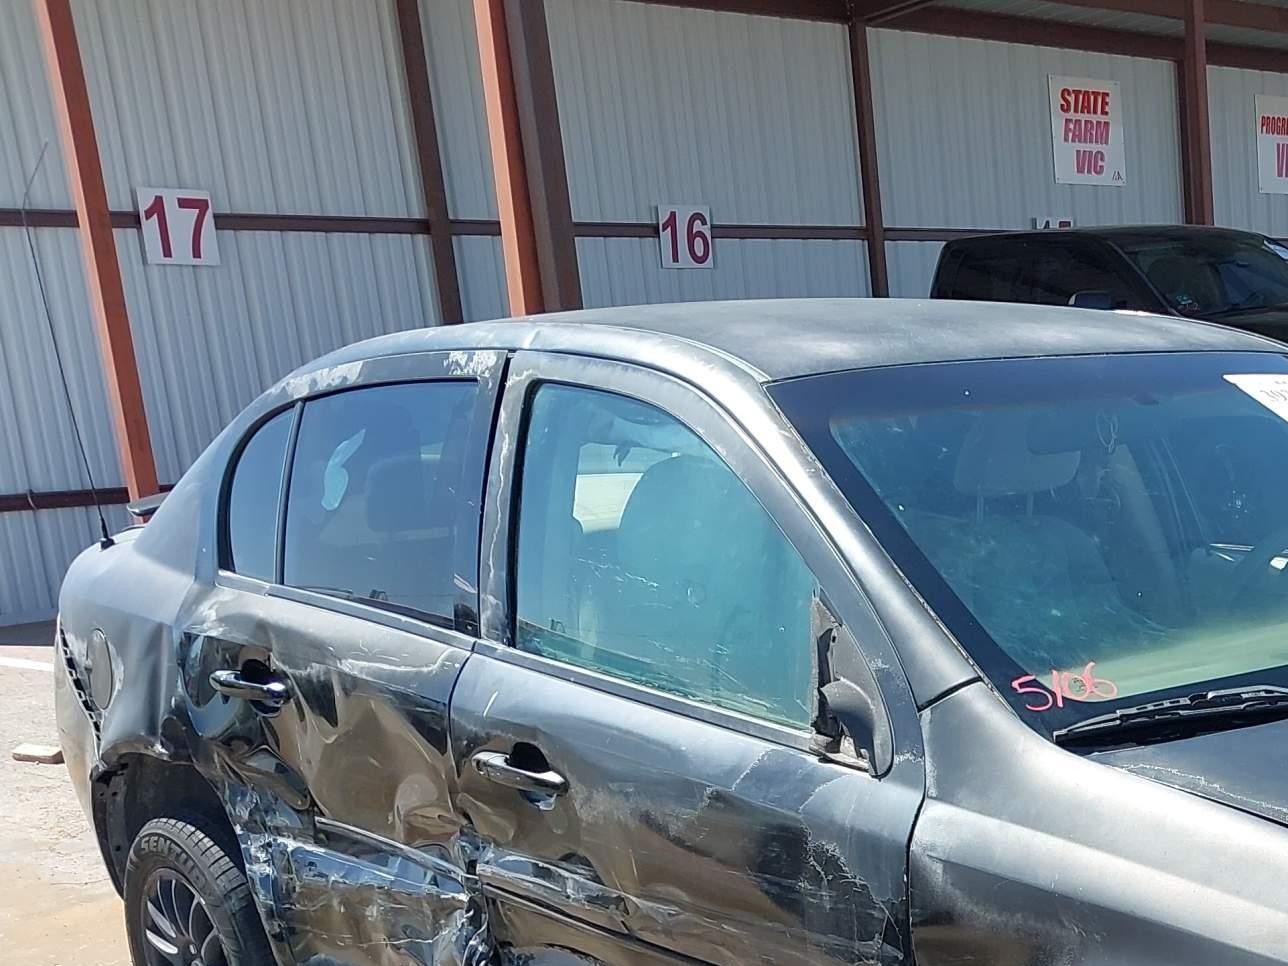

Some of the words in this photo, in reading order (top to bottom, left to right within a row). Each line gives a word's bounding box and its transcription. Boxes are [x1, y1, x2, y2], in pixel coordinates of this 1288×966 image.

[1060, 88, 1110, 116] STATE
[1063, 118, 1111, 146] FARM
[1075, 149, 1105, 176] VIC
[143, 194, 209, 259] 17
[661, 210, 710, 265] 16
